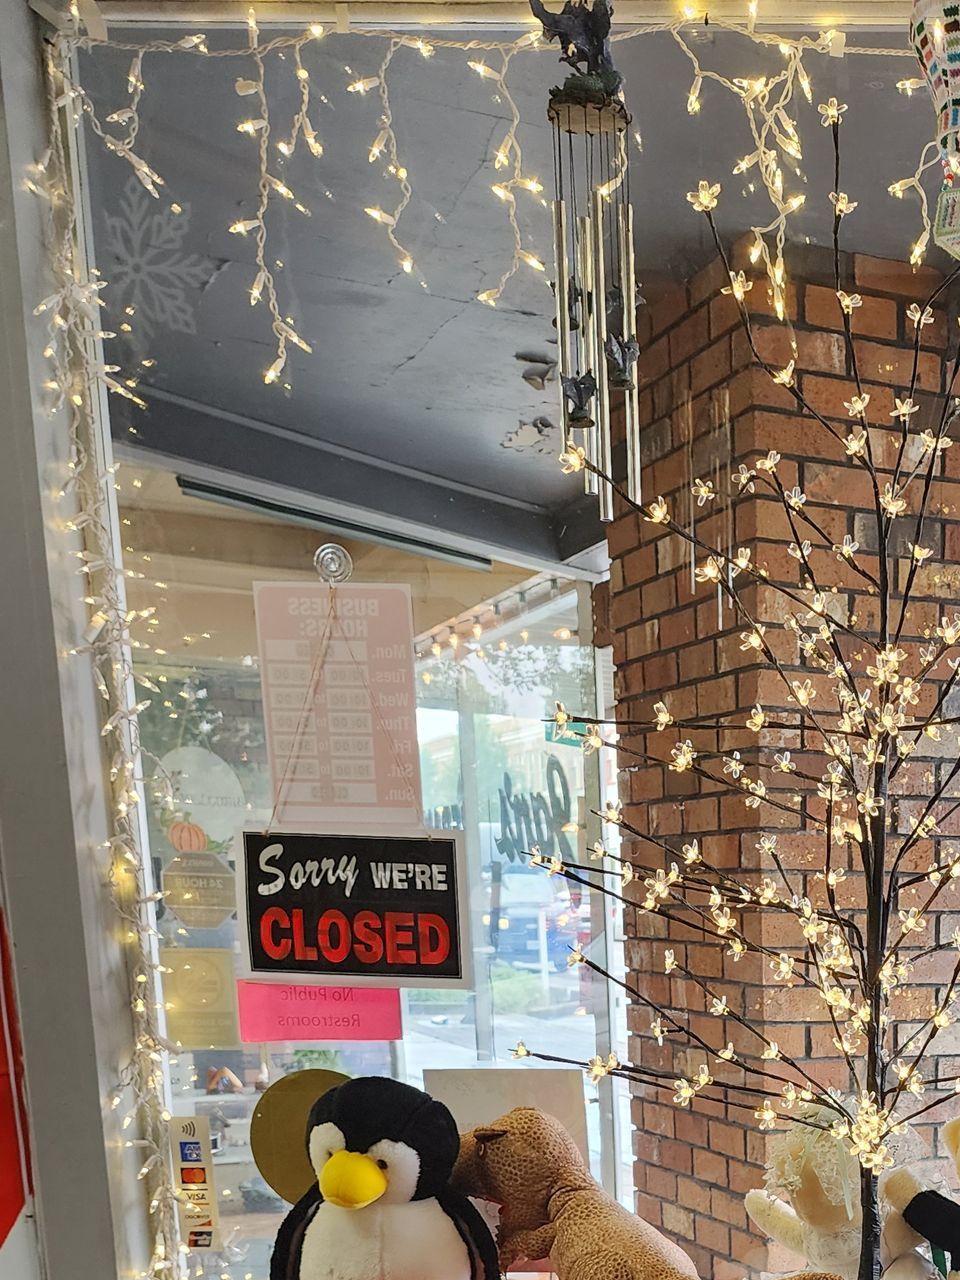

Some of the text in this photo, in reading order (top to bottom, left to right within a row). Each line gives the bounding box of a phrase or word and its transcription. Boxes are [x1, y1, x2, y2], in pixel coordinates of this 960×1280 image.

[257, 843, 448, 897] Sorry WE'RE
[260, 906, 450, 965] CLOSED
[186, 1193, 207, 1201] VISA
